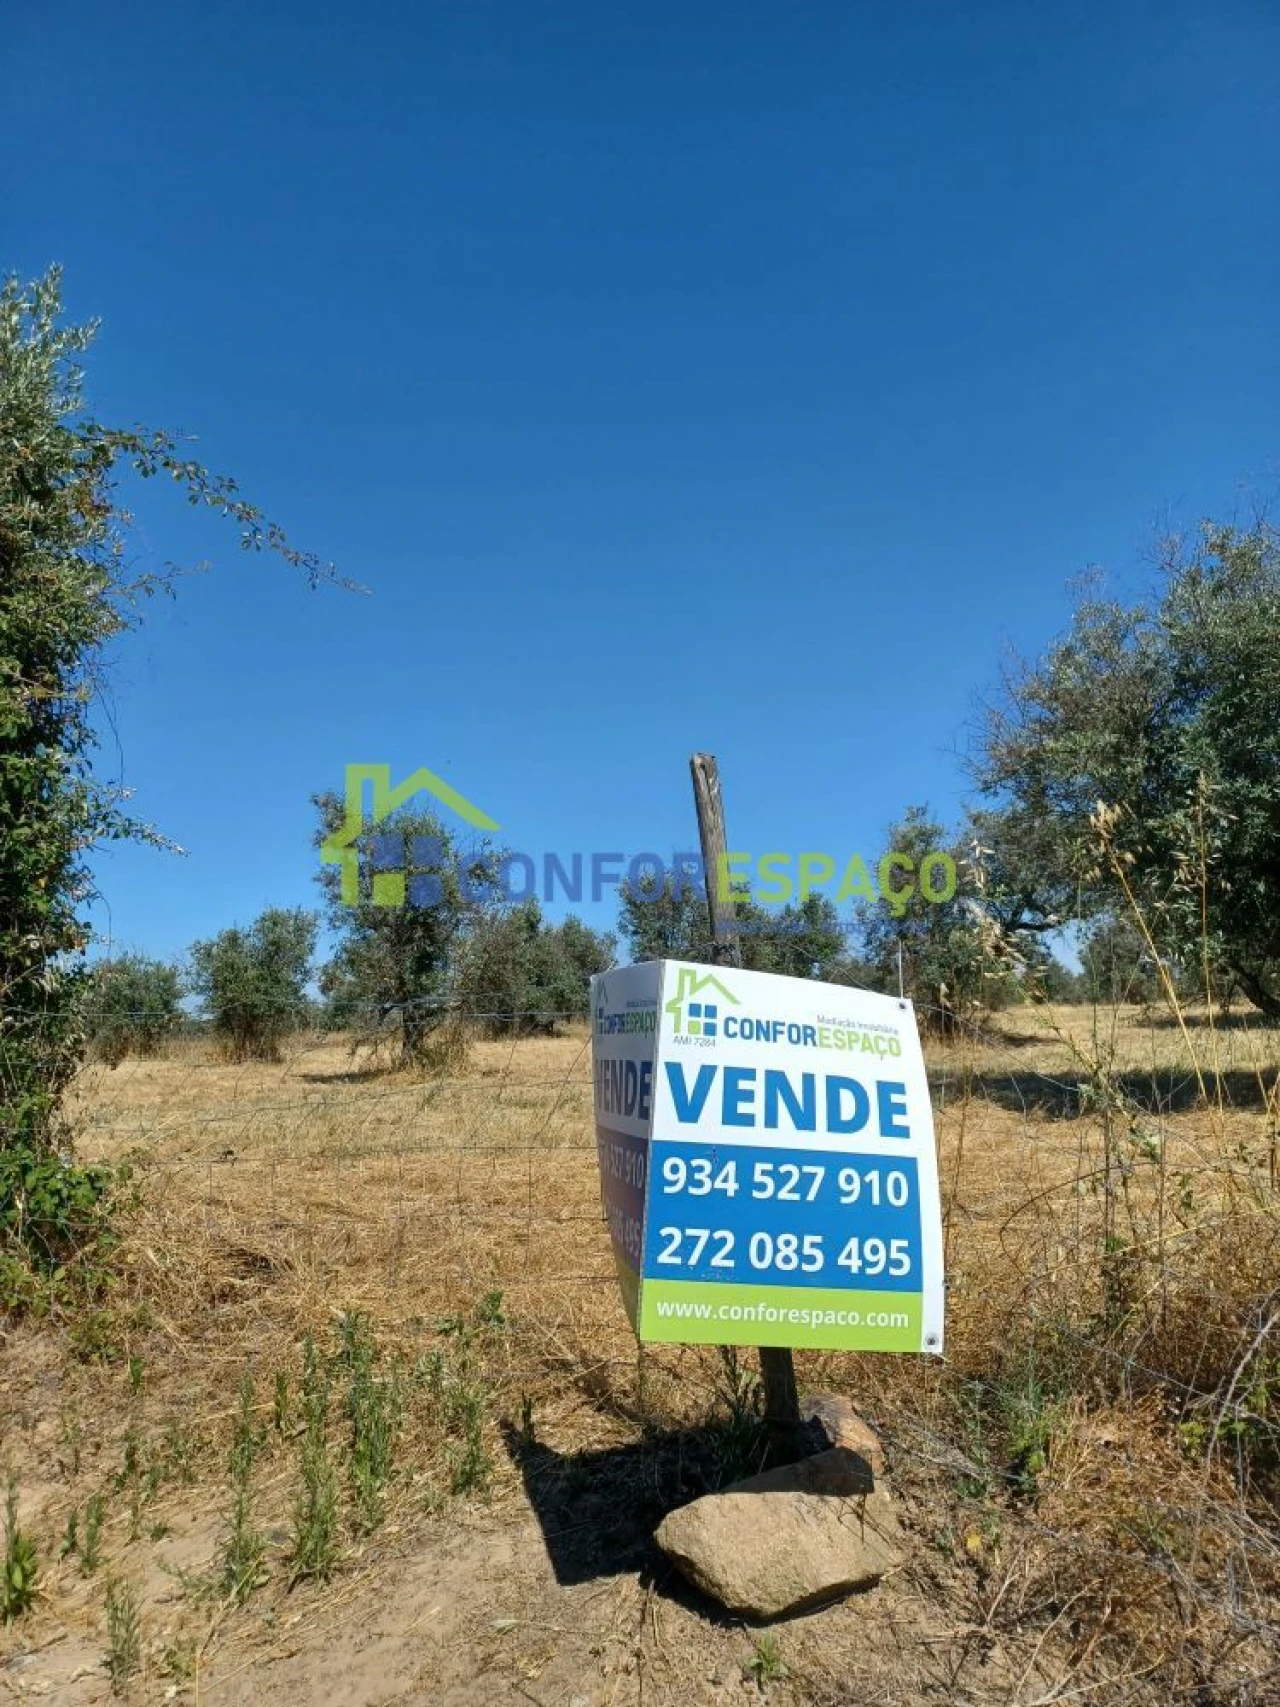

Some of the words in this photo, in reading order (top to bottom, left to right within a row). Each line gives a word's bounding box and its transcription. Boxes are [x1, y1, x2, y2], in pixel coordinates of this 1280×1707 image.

[673, 1035, 692, 1046] AMI
[723, 1016, 901, 1060] CONFORESPAÇO
[664, 1061, 911, 1139] VENDE
[662, 1157, 740, 1198] 934
[752, 1163, 825, 1202] 527
[837, 1168, 909, 1207] 910
[656, 1227, 735, 1268] 272
[749, 1234, 824, 1272] 085
[837, 1237, 911, 1276] 495
[656, 1300, 909, 1328] www.conforespaco.com
